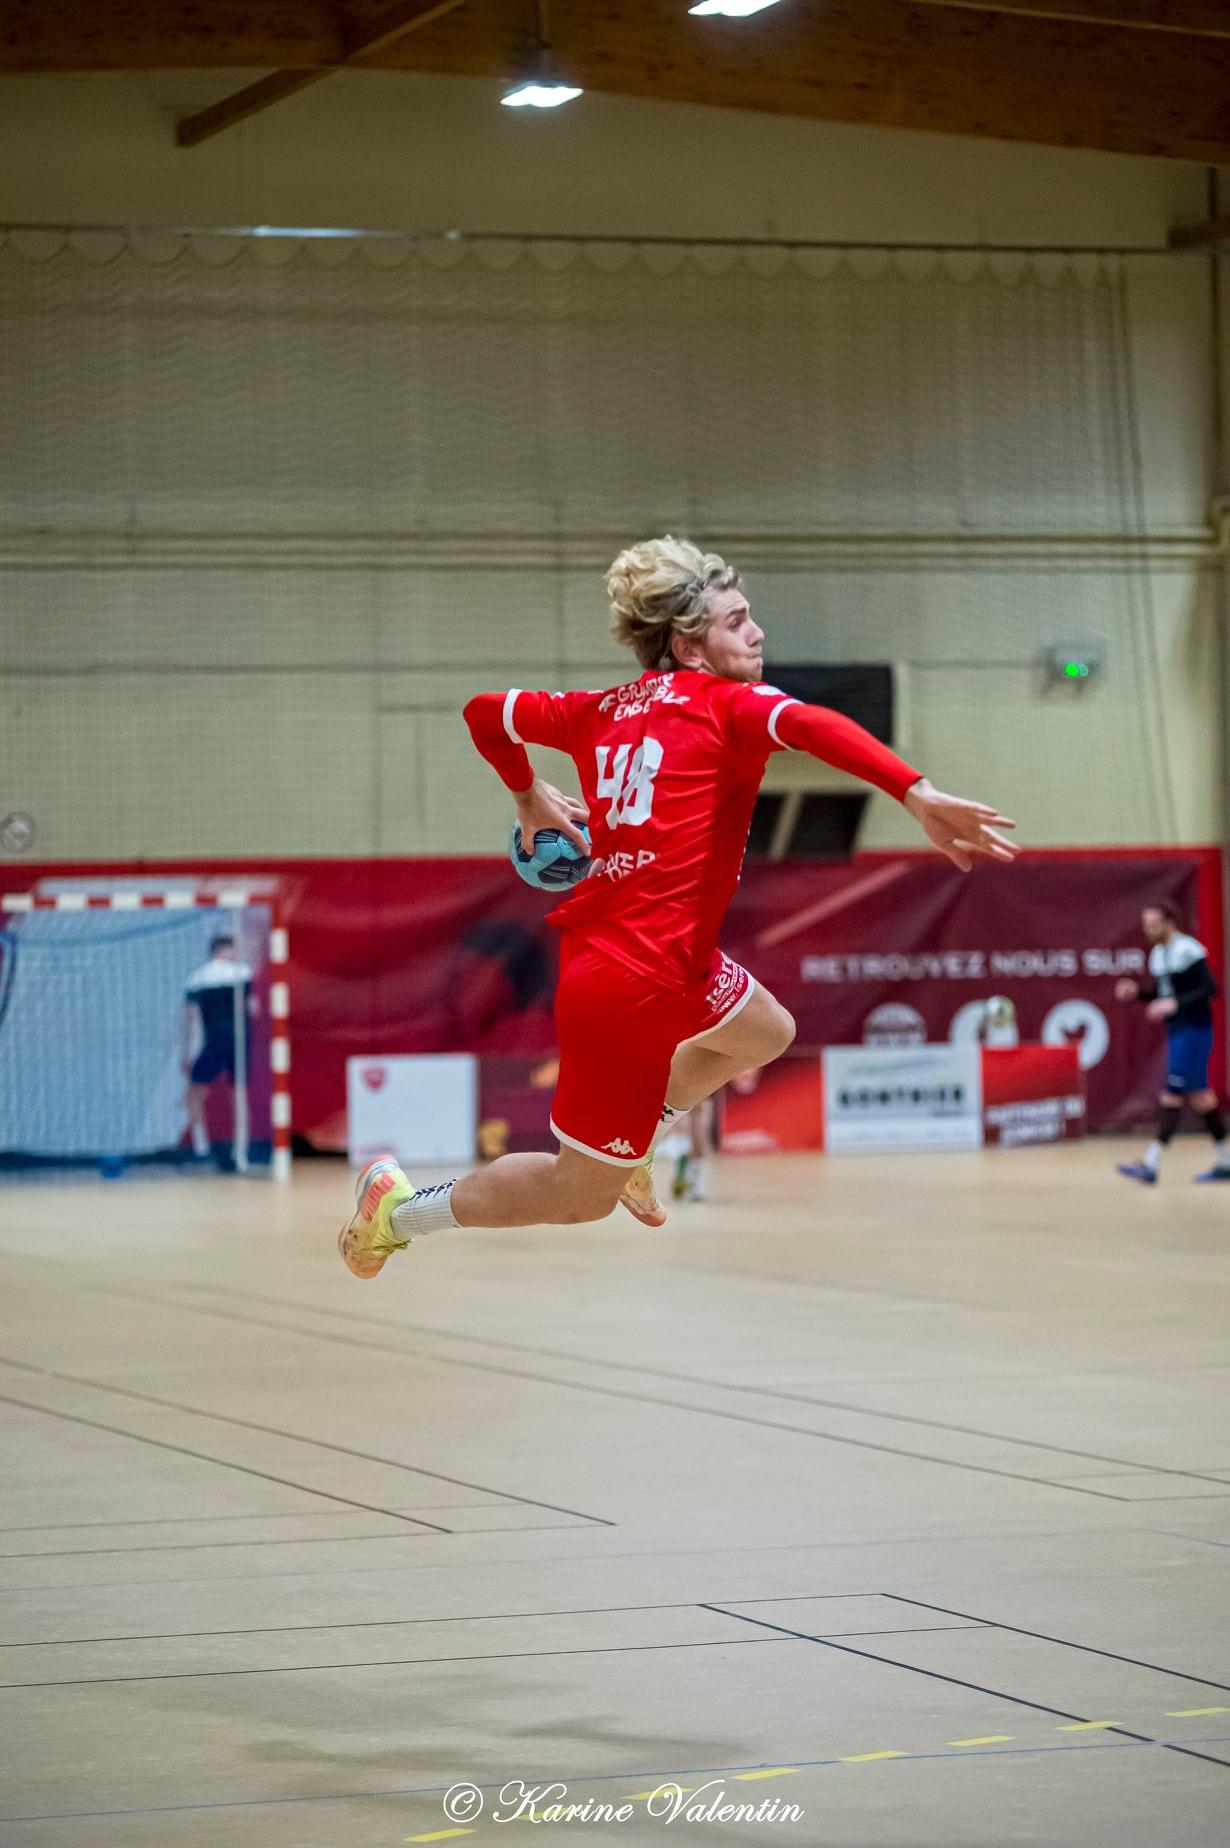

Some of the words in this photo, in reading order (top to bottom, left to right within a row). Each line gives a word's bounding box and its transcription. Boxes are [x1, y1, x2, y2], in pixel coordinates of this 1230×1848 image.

[595, 736, 664, 830] 48
[802, 951, 985, 982] RETROUVEZ
[991, 949, 1078, 977] NOUS
[1083, 948, 1146, 975] SUR
